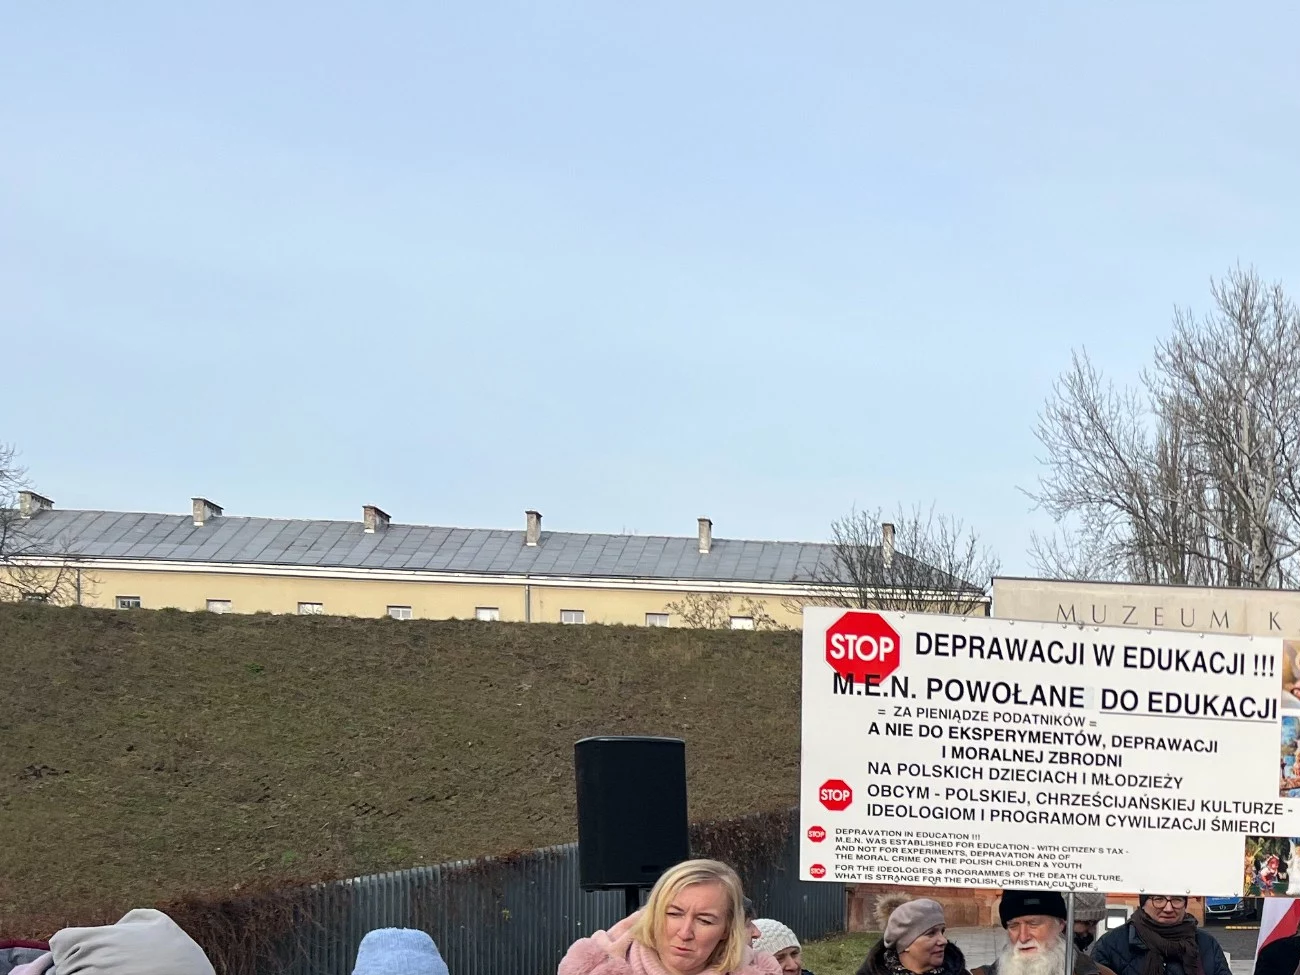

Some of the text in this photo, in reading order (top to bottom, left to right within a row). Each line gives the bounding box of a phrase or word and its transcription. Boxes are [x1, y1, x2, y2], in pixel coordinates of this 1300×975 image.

[1056, 604, 1229, 630] MUZEUM
[830, 633, 895, 662] STOP
[915, 631, 1274, 677] DEPRAWACJI W EDUKACJI !!!
[832, 671, 1277, 719] M.E.N. POWOŁANE DO EDUKACJI
[892, 705, 912, 718] ZA
[915, 706, 989, 723] PIENIĄDZE
[992, 710, 1085, 727] PODATNIKÓW
[867, 721, 1218, 753] A NIE DO EKSPERYMENTÓW, DEPRAWACJI
[941, 744, 1122, 767] I MORALNEJ ZBRODNI
[867, 760, 1183, 789] NA POLSKICH DZIECIACH I MŁODZIEŻY
[821, 788, 851, 802] STOP
[866, 783, 929, 799] OBCYM
[944, 787, 1030, 805] POLSKIEJ,
[1035, 791, 1195, 812] CHRZEŚCIJAŃSKIEJ
[1200, 799, 1283, 815] KULTURZE
[866, 802, 1275, 833] IDEOLOGIOM I PROGRAMOM CYWILIZACJI ŚMIERCI
[807, 830, 826, 838] STOP
[834, 827, 902, 837] DEPRAVATION
[915, 830, 969, 840] EDUCATION
[834, 835, 864, 844] M.E.N.
[864, 836, 888, 845] WAS
[888, 837, 954, 848] ESTABLISHED
[954, 840, 975, 849] FOR
[976, 841, 1030, 851] EDUCATION
[1036, 843, 1060, 852] WITH
[1106, 846, 1124, 855] TAX
[834, 844, 855, 852] AND
[856, 845, 877, 853] NOT
[878, 845, 899, 853] FOR
[900, 846, 967, 857] EXPERIMENTS,
[969, 849, 1035, 859] DEPRAVATION
[1036, 852, 1056, 860] AND
[809, 867, 826, 875] STOP
[834, 852, 1082, 869] THE MORAL CRIME ON THE POLISH CHILDREN & YOUTH
[834, 863, 854, 871] FOR
[856, 864, 874, 872] THE
[876, 865, 934, 874] IDEOLOGIES
[935, 867, 942, 875] &
[944, 867, 1011, 877] PROGRAMMES
[1012, 870, 1025, 878] OF
[1046, 871, 1077, 879] DEATH
[1078, 872, 1123, 882] CULTURE,
